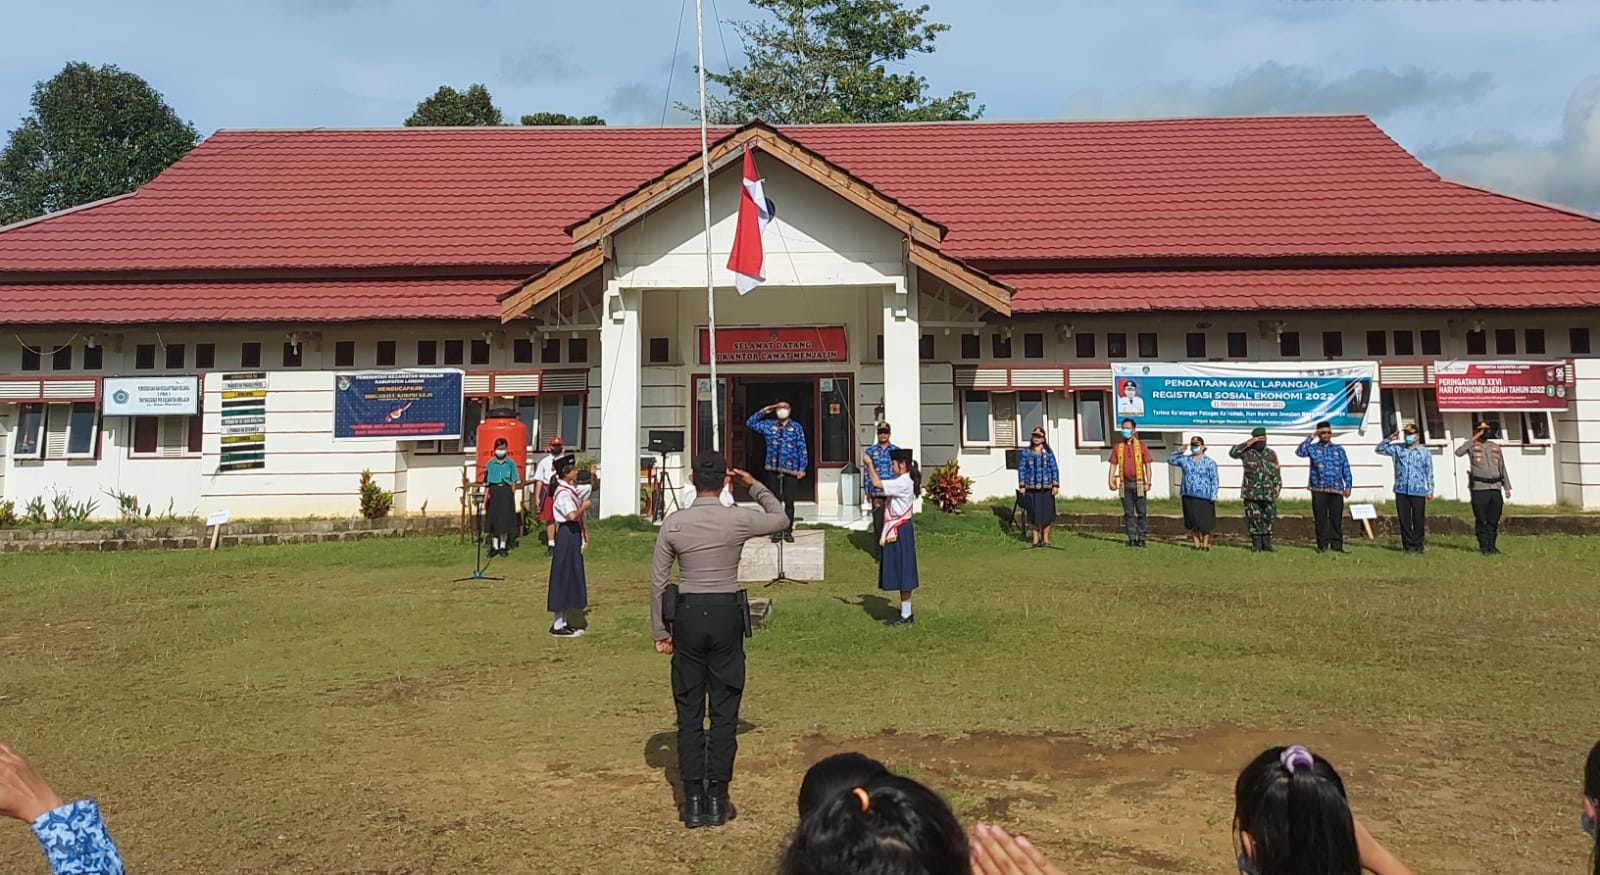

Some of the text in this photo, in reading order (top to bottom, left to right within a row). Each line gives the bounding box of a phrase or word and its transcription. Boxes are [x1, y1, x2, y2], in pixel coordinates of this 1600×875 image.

[734, 341, 812, 350] SELAMAT DATANG
[722, 353, 759, 361] KANTOR
[761, 352, 791, 360] CAMAT
[792, 351, 838, 360] MENJALIN
[1164, 379, 1318, 389] PENDATAAN AWAL LAPANGAN
[1438, 378, 1502, 386] PERINGATAN KE XXVI
[1438, 386, 1546, 394] HARI OTONOMI DAERAH TAHUN 2022
[1152, 391, 1335, 401] REGISTRASI SOSIAL EKONOMI 2022
